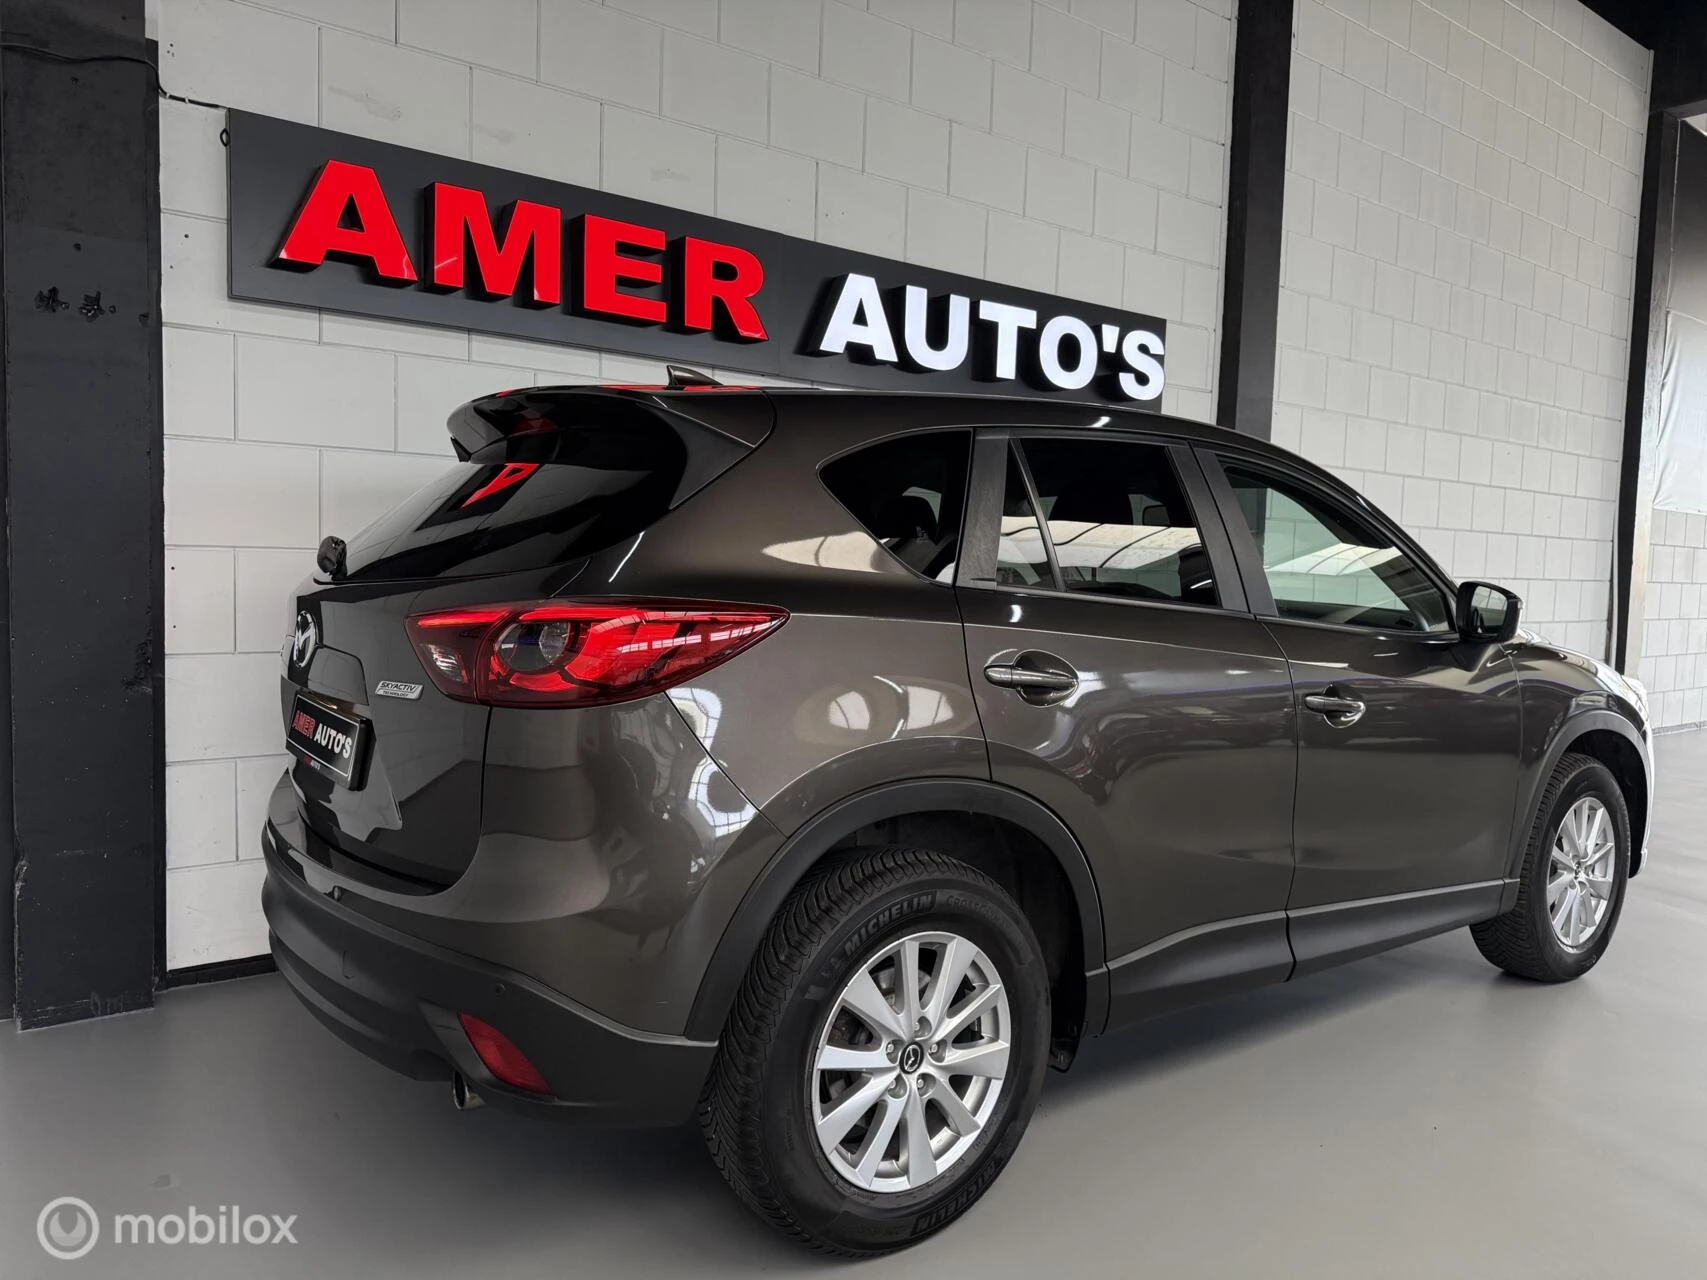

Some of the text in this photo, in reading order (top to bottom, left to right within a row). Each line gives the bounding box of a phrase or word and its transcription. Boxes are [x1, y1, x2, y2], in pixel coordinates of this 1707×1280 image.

[278, 159, 1165, 402] AMER AUTO'S
[380, 681, 417, 692] SKYACTIV
[292, 710, 352, 759] AMER AUTO'S
[845, 894, 933, 957] MICHELIN
[916, 1161, 997, 1232] MICHELIN
